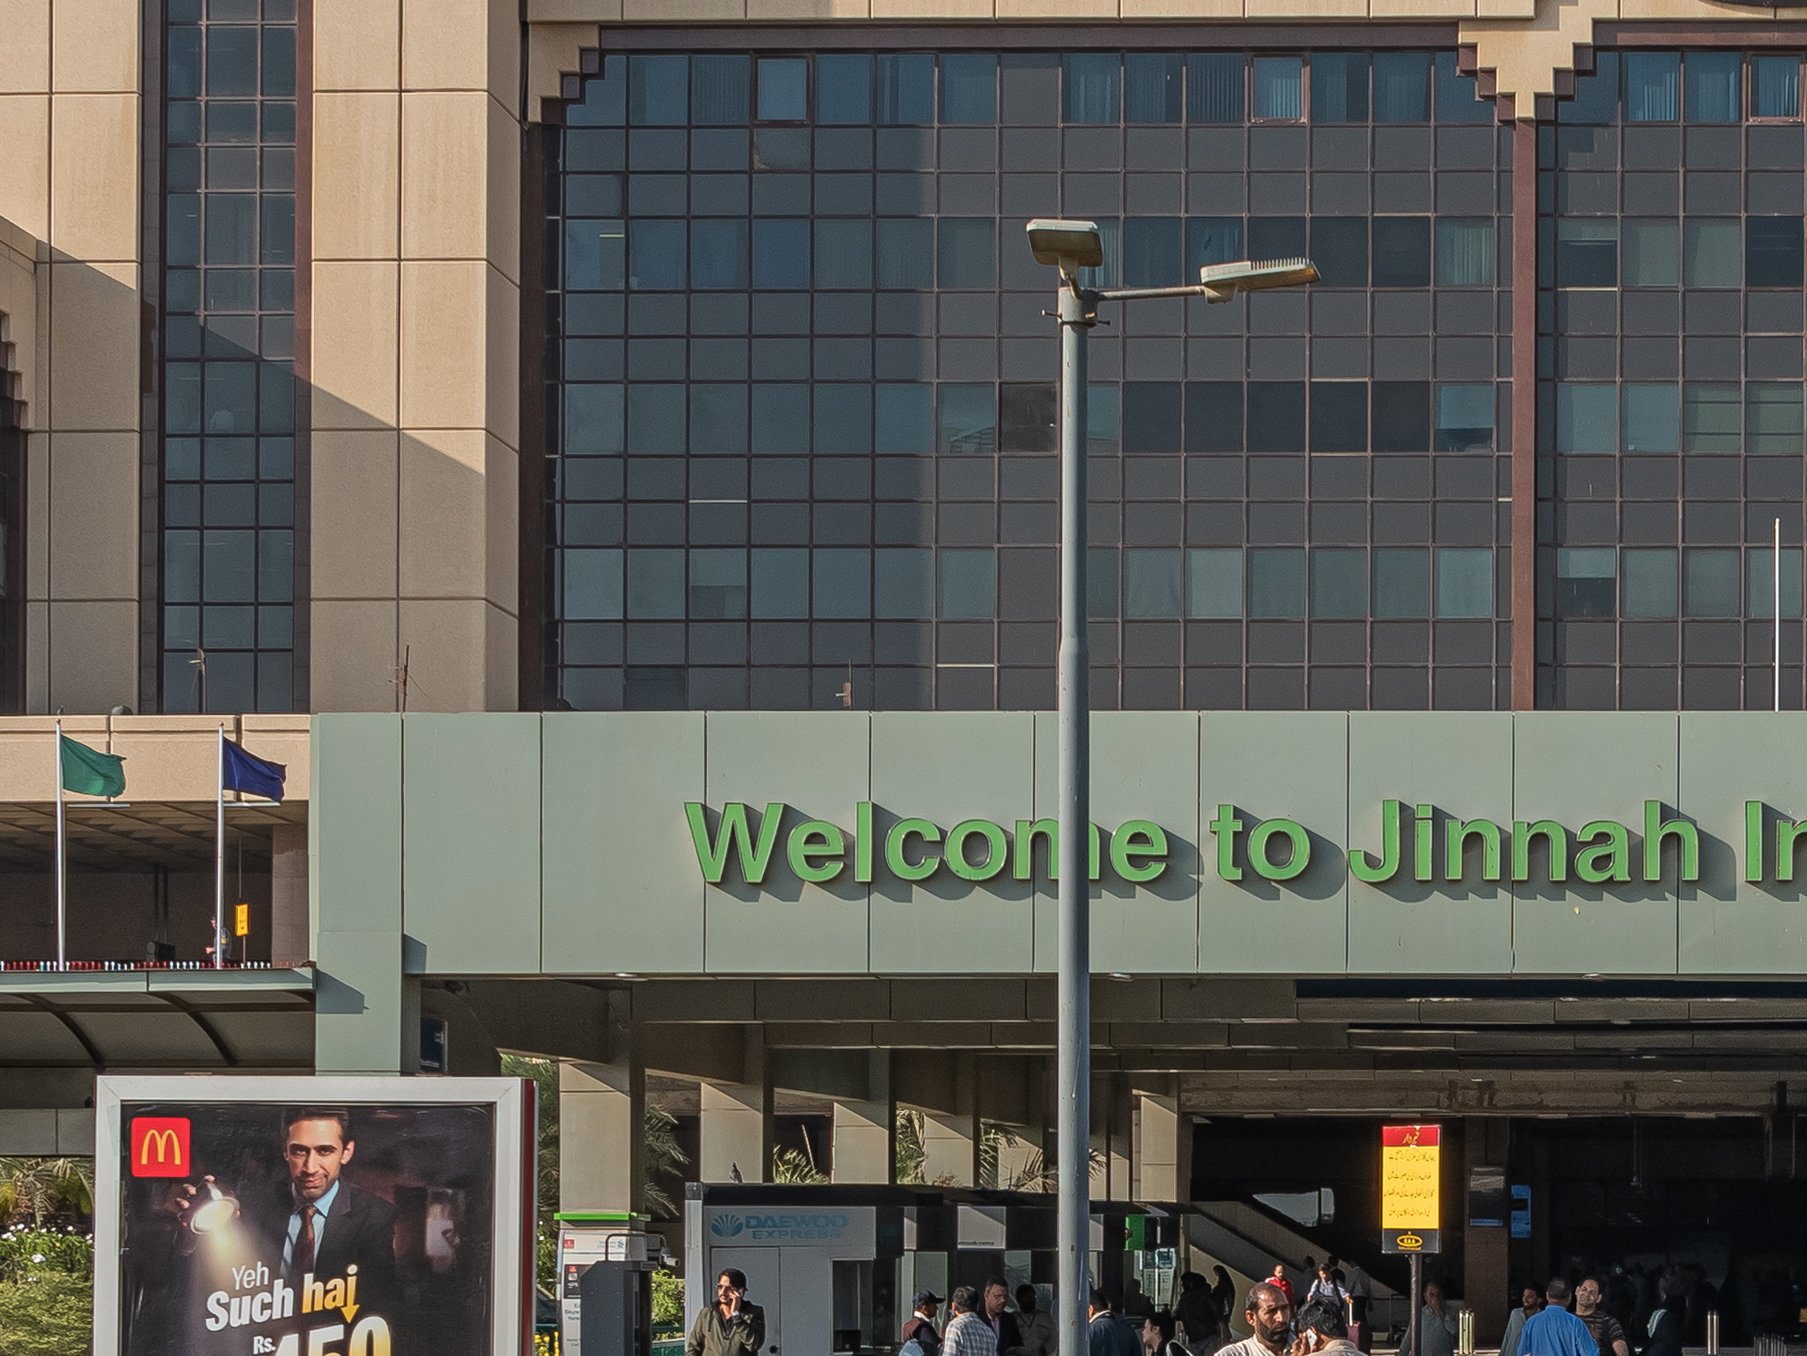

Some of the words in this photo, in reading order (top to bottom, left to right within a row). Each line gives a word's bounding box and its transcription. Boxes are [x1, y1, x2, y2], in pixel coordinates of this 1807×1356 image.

[683, 800, 1170, 884] Welcome
[1209, 803, 1311, 883] to
[1347, 799, 1700, 883] Jinnah
[745, 1215, 849, 1230] DAEWOO
[751, 1229, 842, 1240] EXPRESS
[232, 1261, 270, 1291] Yeh
[205, 1278, 294, 1332] Such
[302, 1264, 360, 1323] hai
[253, 1335, 277, 1355] Rs.
